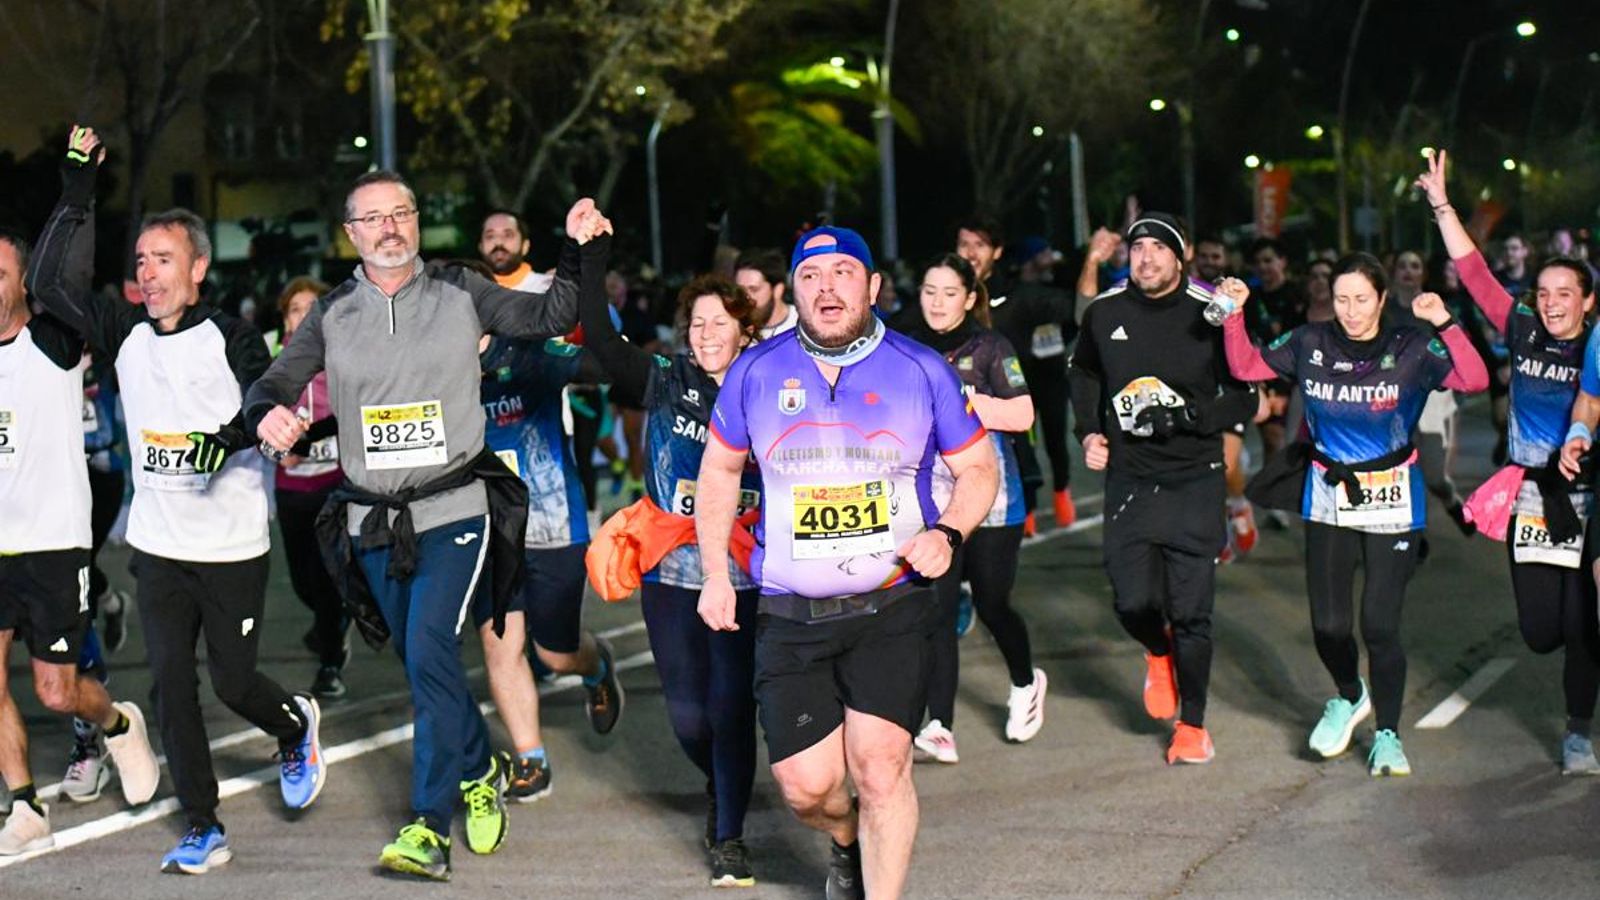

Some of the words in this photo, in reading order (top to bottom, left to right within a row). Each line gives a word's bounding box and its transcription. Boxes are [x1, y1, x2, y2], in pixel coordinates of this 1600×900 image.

[1305, 379, 1333, 400] SAN
[1337, 381, 1399, 402] ANTÓN
[370, 421, 434, 444] 9825
[147, 446, 186, 468] 867
[811, 488, 828, 500] 42
[1361, 485, 1401, 504] 848
[800, 501, 878, 531] 4031
